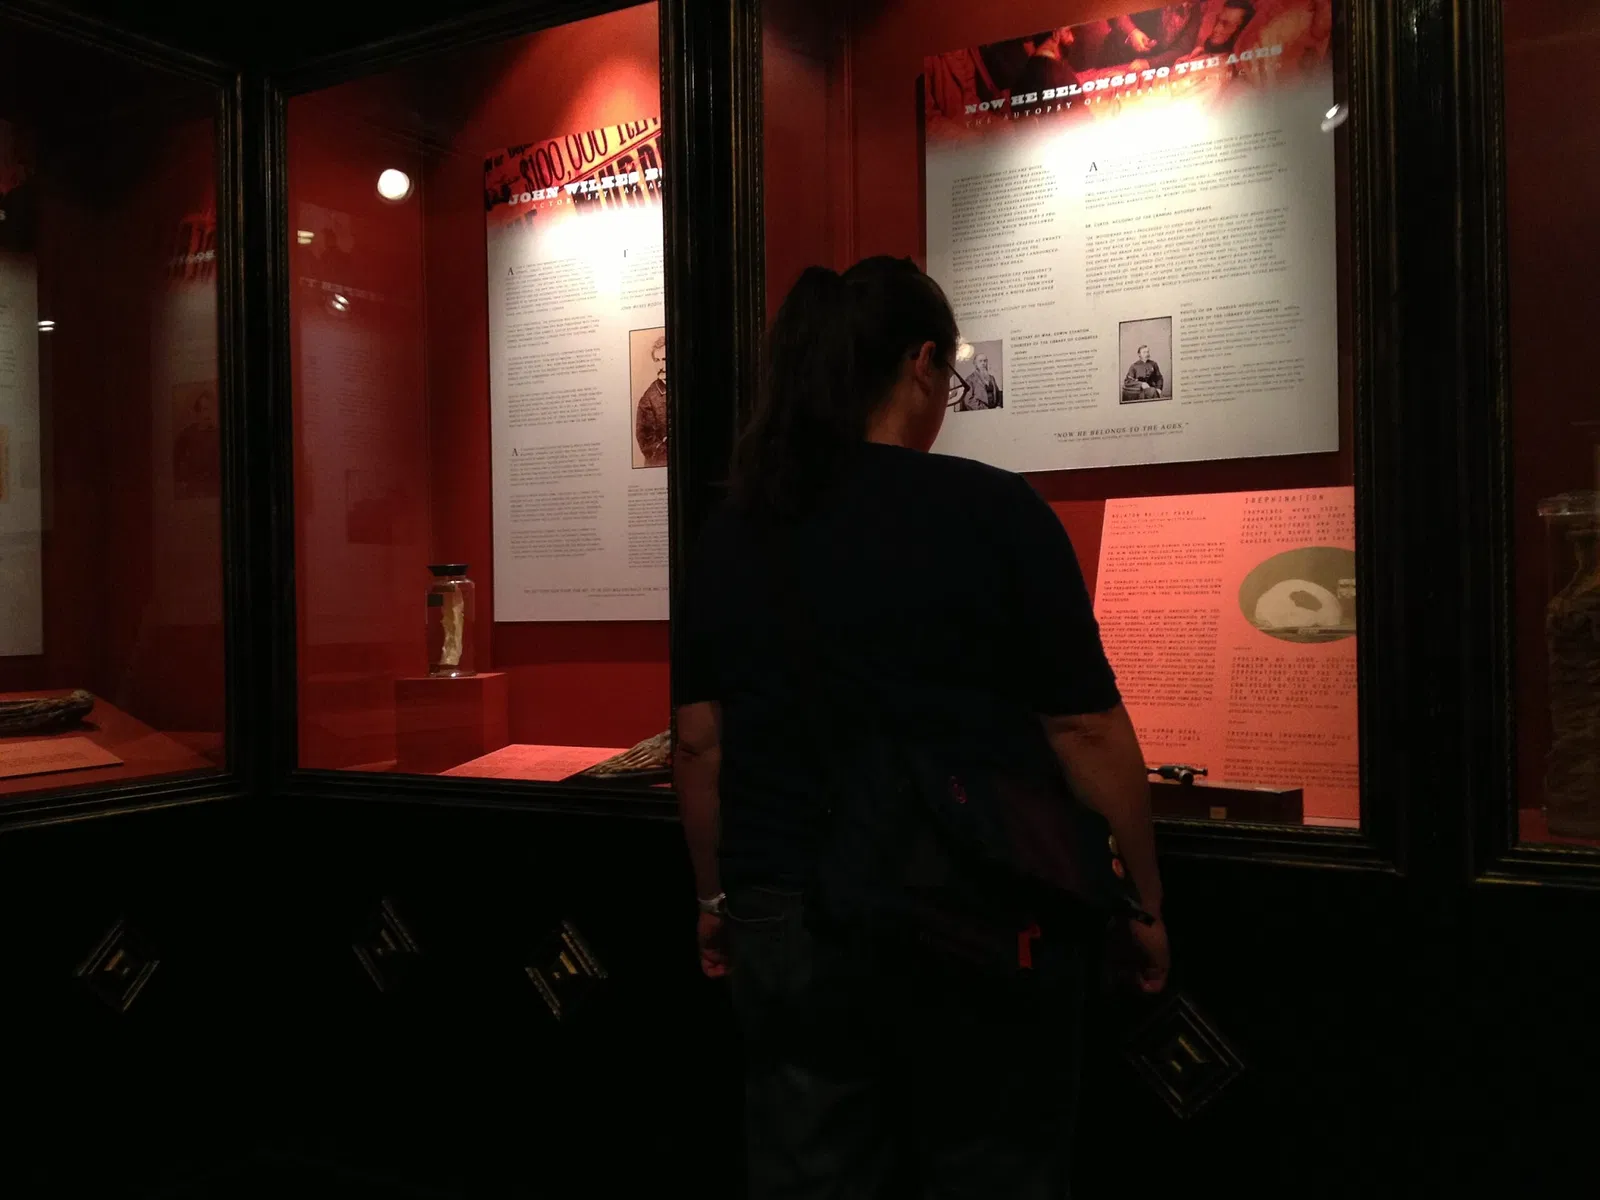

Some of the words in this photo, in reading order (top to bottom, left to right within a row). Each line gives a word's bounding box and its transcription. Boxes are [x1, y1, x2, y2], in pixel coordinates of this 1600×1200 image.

[964, 97, 1007, 115] NOW
[1011, 92, 1038, 107] HE
[1042, 72, 1137, 101] BELONGS
[1141, 66, 1171, 83] TO
[1175, 56, 1220, 75] THE
[1226, 44, 1283, 66] AGES
[965, 117, 993, 129] THE
[1003, 101, 1072, 121] AUTOPSY
[1084, 96, 1101, 107] OF
[508, 186, 559, 206] JOHN
[564, 171, 640, 195] WILKES
[587, 191, 608, 201] SPY
[1090, 427, 1126, 435] BELONGS
